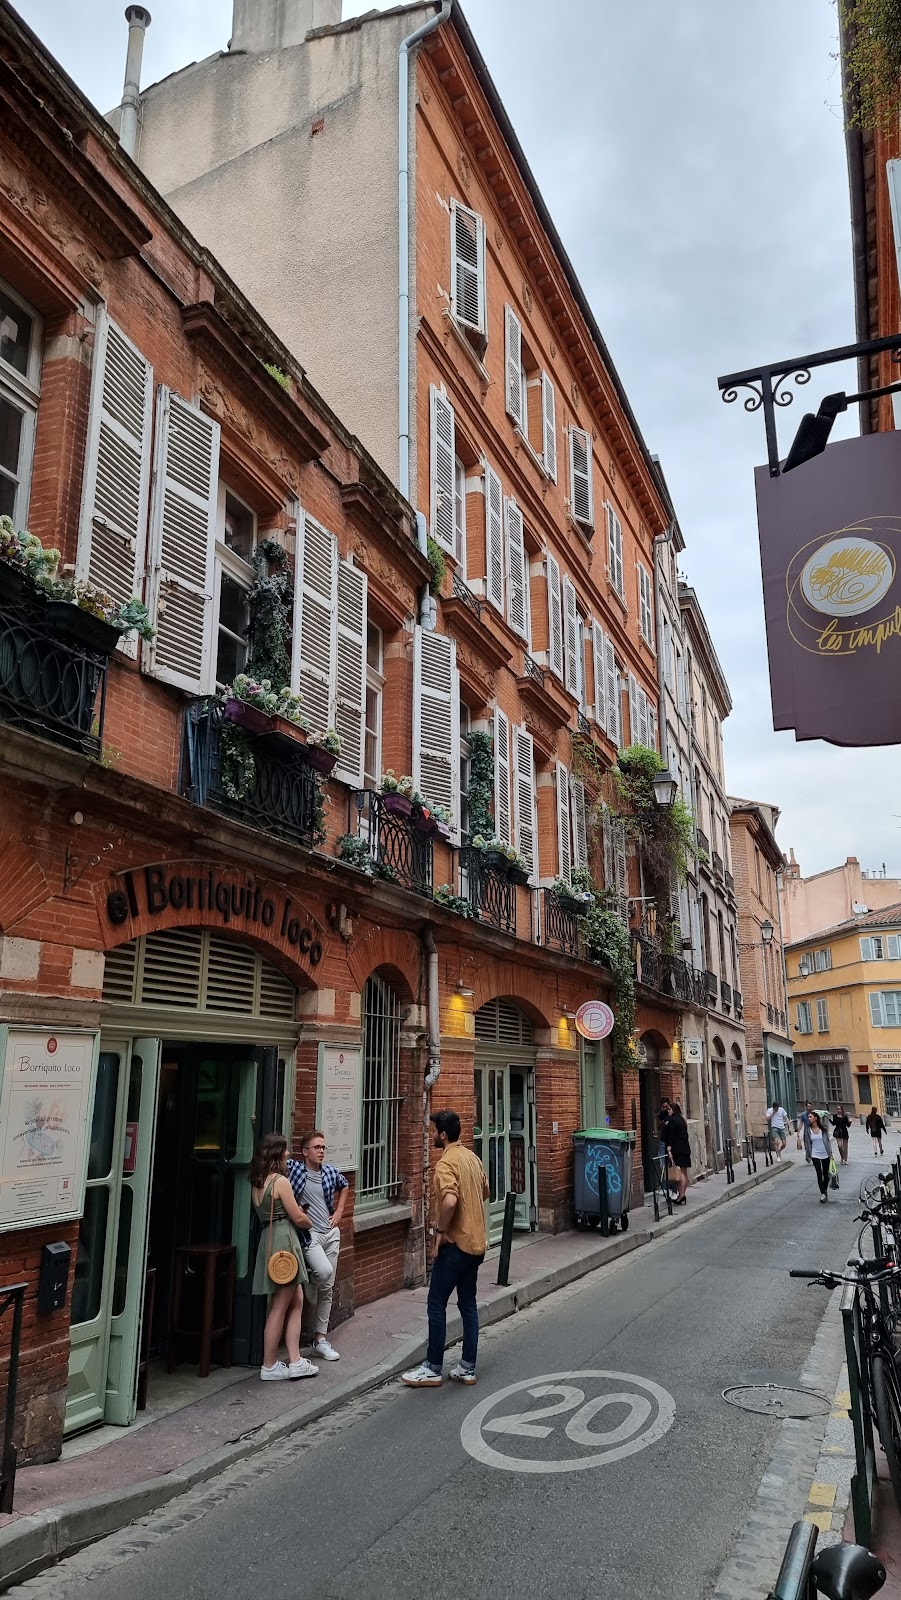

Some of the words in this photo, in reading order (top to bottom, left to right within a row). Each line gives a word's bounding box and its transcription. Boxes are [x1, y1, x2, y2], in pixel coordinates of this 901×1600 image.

[107, 871, 139, 924] el
[145, 866, 275, 927] Borriquito
[281, 897, 323, 966] loco
[585, 1012, 603, 1029] B
[18, 1055, 62, 1075] Borriquito
[481, 1385, 652, 1446] 20
